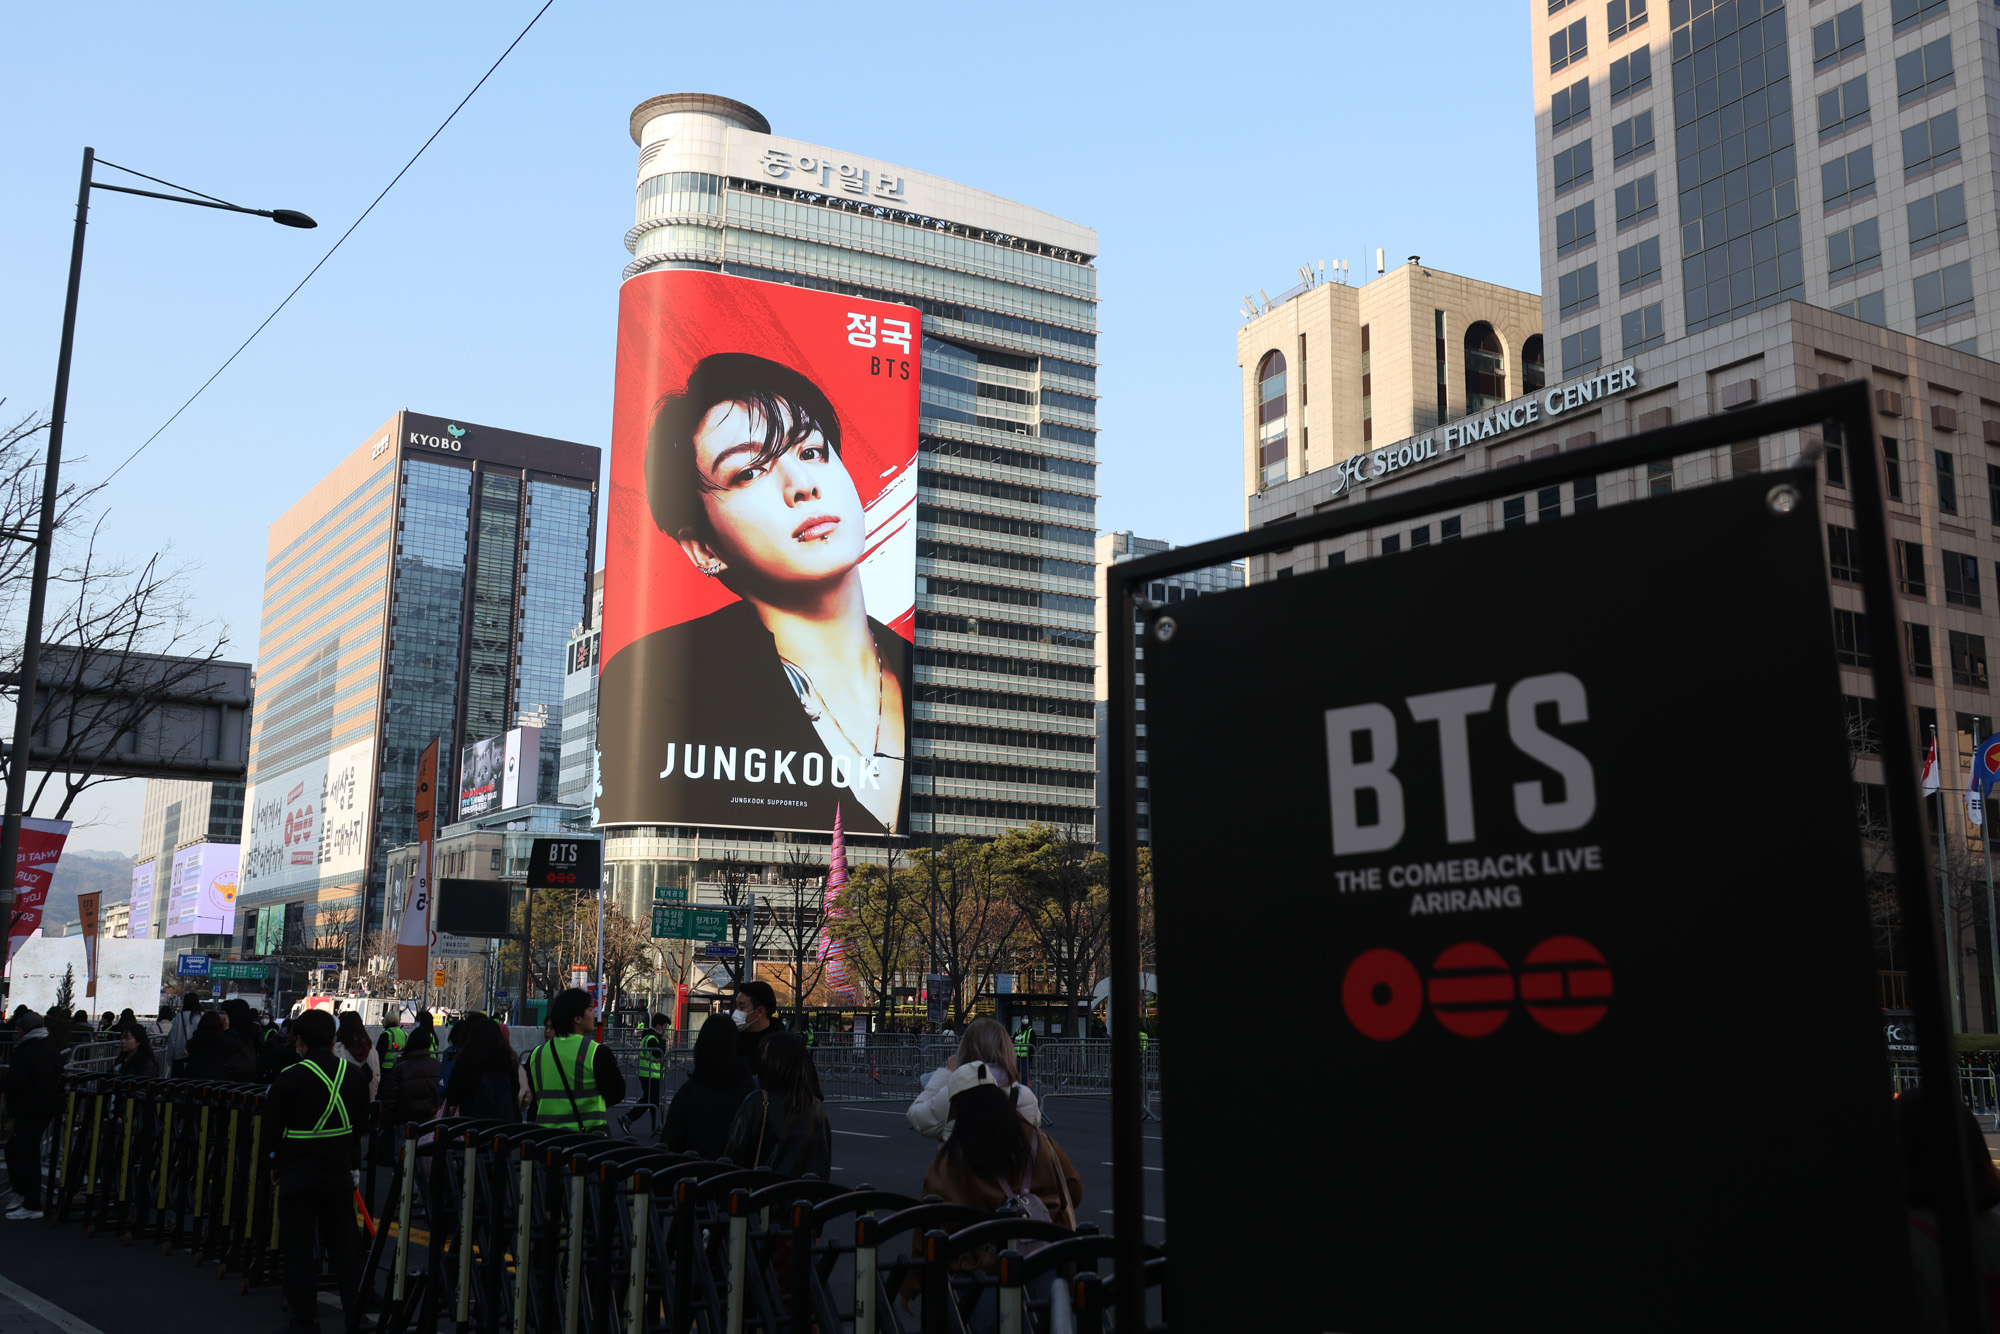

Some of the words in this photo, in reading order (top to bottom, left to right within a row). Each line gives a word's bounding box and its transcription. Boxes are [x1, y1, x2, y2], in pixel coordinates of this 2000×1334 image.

[757, 148, 903, 201] 동아일보
[846, 312, 912, 355] 정국
[871, 356, 910, 381] BTS
[1372, 438, 1438, 477] SEOUL
[1444, 400, 1539, 453] FINANCE
[1544, 365, 1638, 416] CENTER
[410, 432, 461, 451] KYOBO
[659, 742, 881, 791] JUNGKOOK
[1325, 672, 1597, 856] BTS
[730, 797, 765, 805] JUNGKOOK
[767, 798, 808, 807] SUPPORTERS
[549, 843, 578, 862] BTS
[1335, 868, 1382, 893] THE
[1388, 853, 1535, 888] COMEBACK
[1542, 846, 1603, 875] LIVE
[660, 889, 684, 898] 청계광장
[1410, 885, 1522, 916] ARIRANG
[663, 910, 684, 918] 독립문
[663, 917, 684, 928] 광화문
[696, 916, 720, 925] 청계1가
